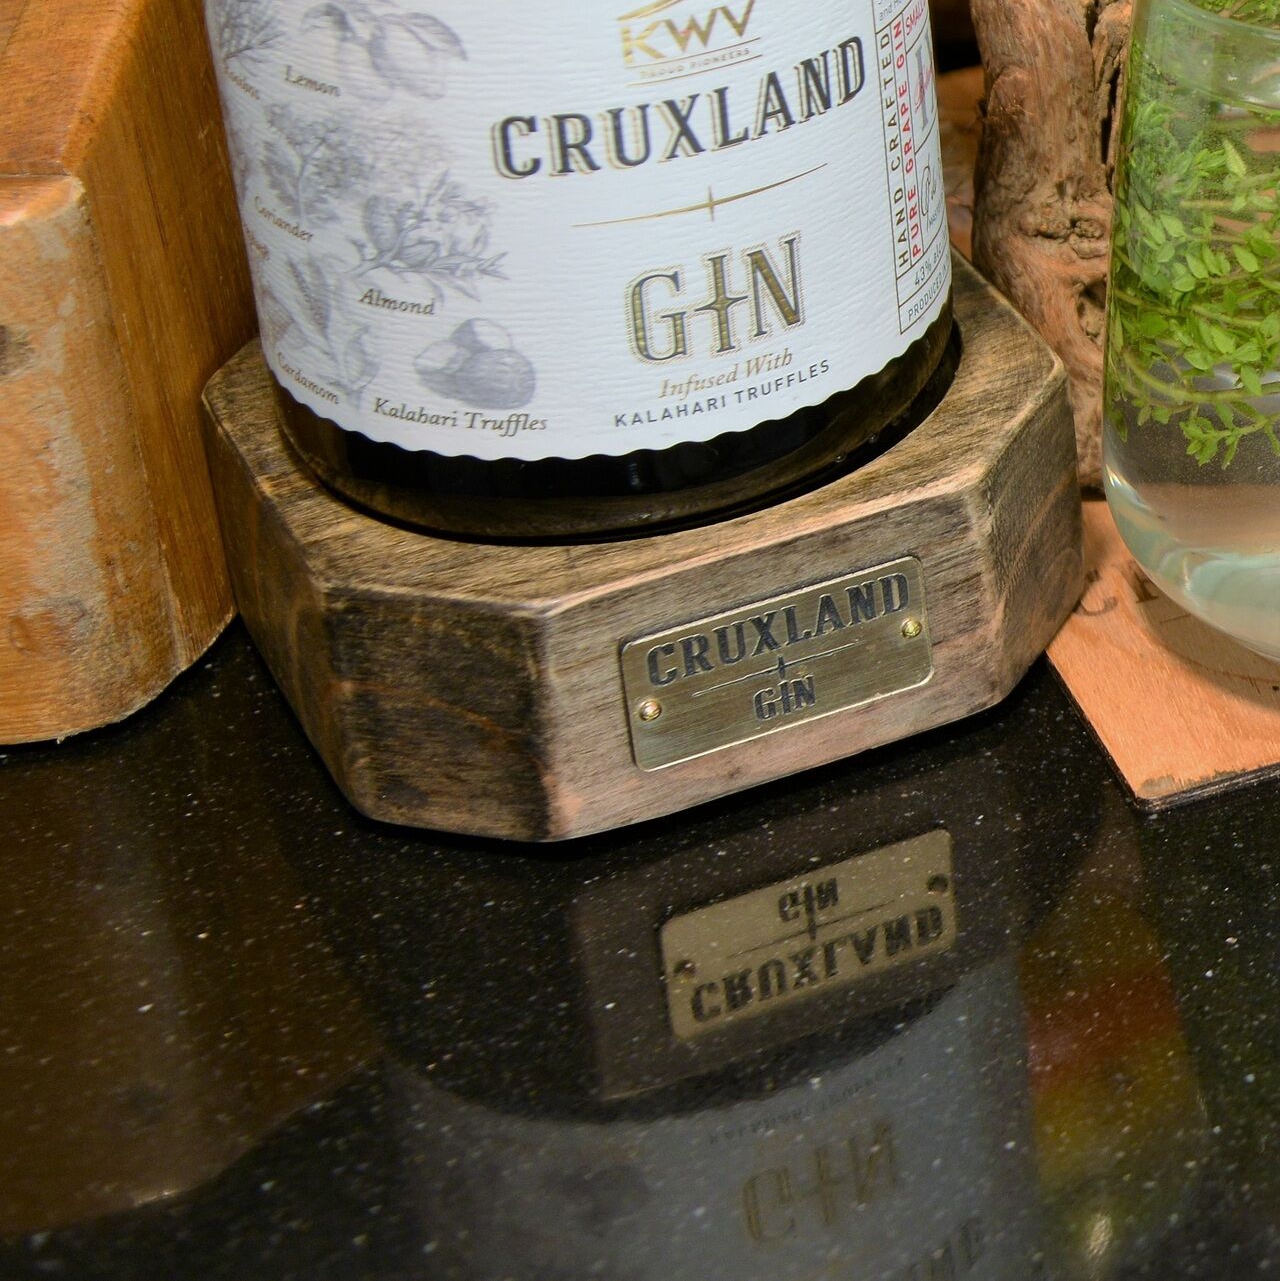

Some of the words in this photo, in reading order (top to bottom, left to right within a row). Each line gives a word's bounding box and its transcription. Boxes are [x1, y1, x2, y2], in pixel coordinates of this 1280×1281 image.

[689, 47, 751, 69] PIONEERS
[893, 20, 905, 70] GIN
[285, 65, 340, 97] Lemon
[491, 36, 866, 179] CRUXLAND
[880, 32, 900, 172] CRAFTED
[898, 81, 914, 174] GRAPE
[894, 187, 909, 269] HAND
[907, 185, 922, 259] PURE
[358, 287, 436, 317] Almond
[627, 232, 803, 364] GIN
[276, 351, 340, 405] Cardamom
[615, 395, 726, 427] KALAHARI
[734, 359, 830, 404] TRUFFLES
[658, 364, 739, 400] Infused
[745, 348, 793, 377] With
[373, 397, 458, 428] Kalahari
[464, 411, 547, 437] Truffles
[646, 572, 911, 687] CRUXLAND
[753, 674, 816, 721] GIN
